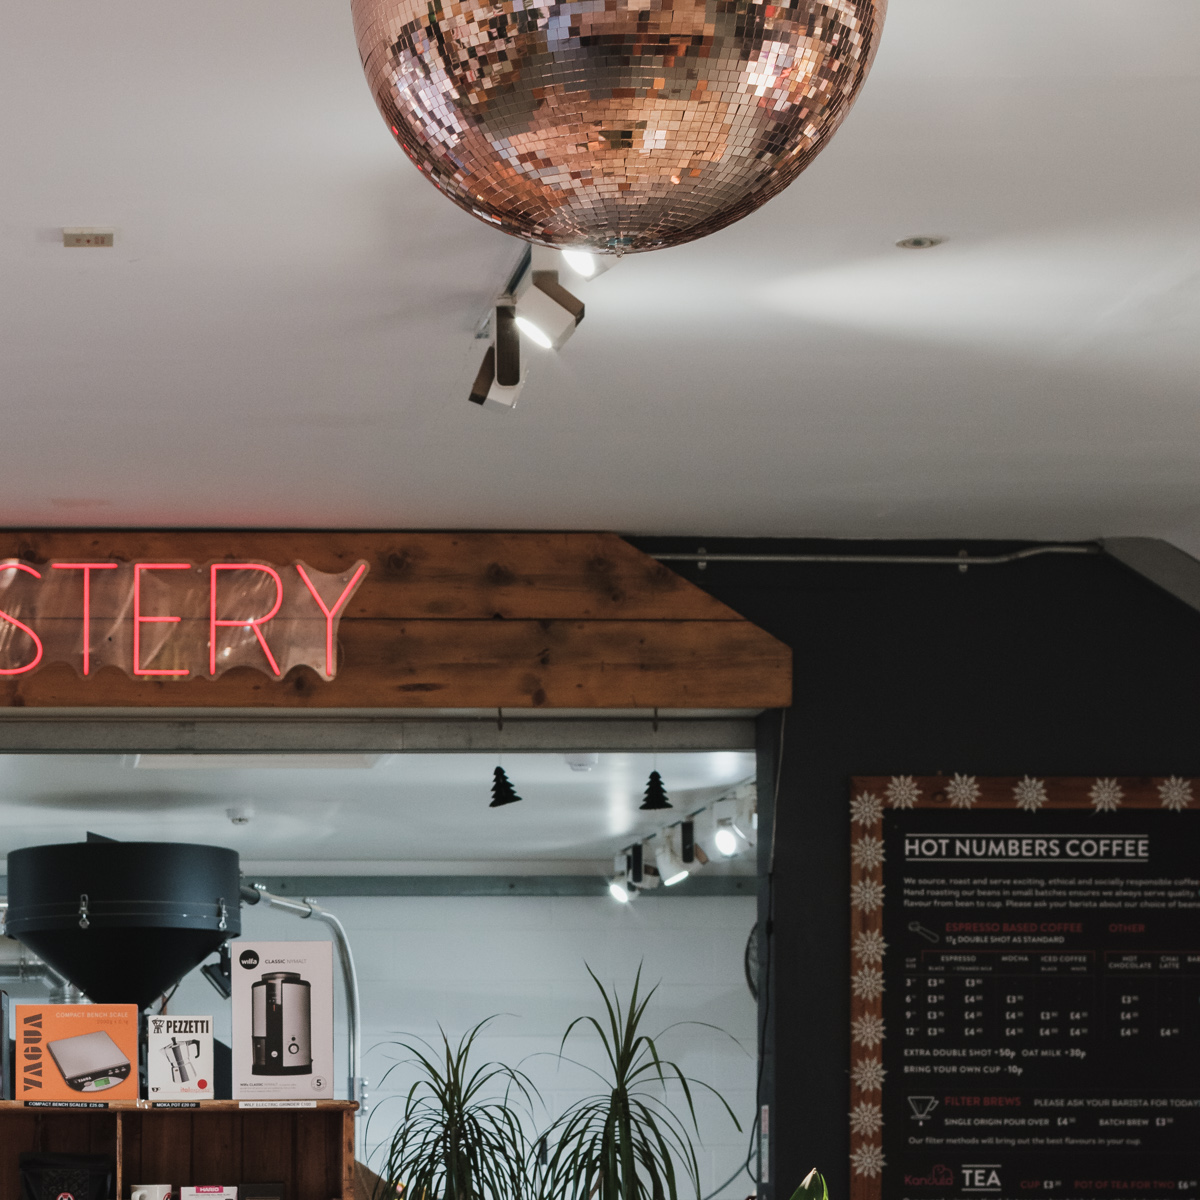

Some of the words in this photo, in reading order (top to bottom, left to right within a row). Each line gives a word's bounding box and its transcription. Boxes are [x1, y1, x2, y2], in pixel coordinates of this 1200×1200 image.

[904, 839, 949, 857] HOT
[955, 839, 1060, 857] NUMBERS
[1065, 839, 1149, 857] COFFEE
[945, 922, 1001, 932] ESPRESSO
[1002, 922, 1038, 933] BASED
[1039, 922, 1082, 933] COFFEE
[1108, 923, 1145, 933] OTHER
[957, 935, 989, 943] DOUBLE
[1023, 936, 1065, 944] STANDARD
[1122, 955, 1138, 963] HOT
[166, 1020, 209, 1033] PEZZETTI
[24, 1013, 42, 1092] YAGUA
[903, 1048, 931, 1056] EXTRA
[932, 1048, 967, 1057] DOUBLE
[968, 1049, 992, 1057] SHOT
[1021, 1049, 1039, 1057] OAT
[903, 1065, 931, 1073] BRING
[933, 1065, 958, 1073] YOUR
[982, 1066, 1001, 1074] CUP
[944, 1096, 981, 1106] FILTER
[982, 1096, 1021, 1106] BREWS
[1033, 1098, 1065, 1107] PLEASE
[1066, 1099, 1084, 1107] ASK
[1086, 1099, 1111, 1107] YOUR
[1111, 1099, 1149, 1107] BARISTA
[1150, 1099, 1168, 1107] FOR
[944, 1118, 972, 1126] SINGLE
[973, 1118, 1003, 1126] ORIGIN
[1027, 1118, 1050, 1126] OVER
[1098, 1118, 1126, 1126] BATCH
[1126, 1118, 1149, 1126] BREW
[962, 1170, 1002, 1187] TEA
[1019, 1180, 1041, 1189] CUP
[1073, 1180, 1093, 1189] POT
[1094, 1180, 1109, 1190] OF
[1110, 1180, 1129, 1189] TEA
[1129, 1180, 1151, 1189] FOR
[1152, 1180, 1175, 1189] TWO
